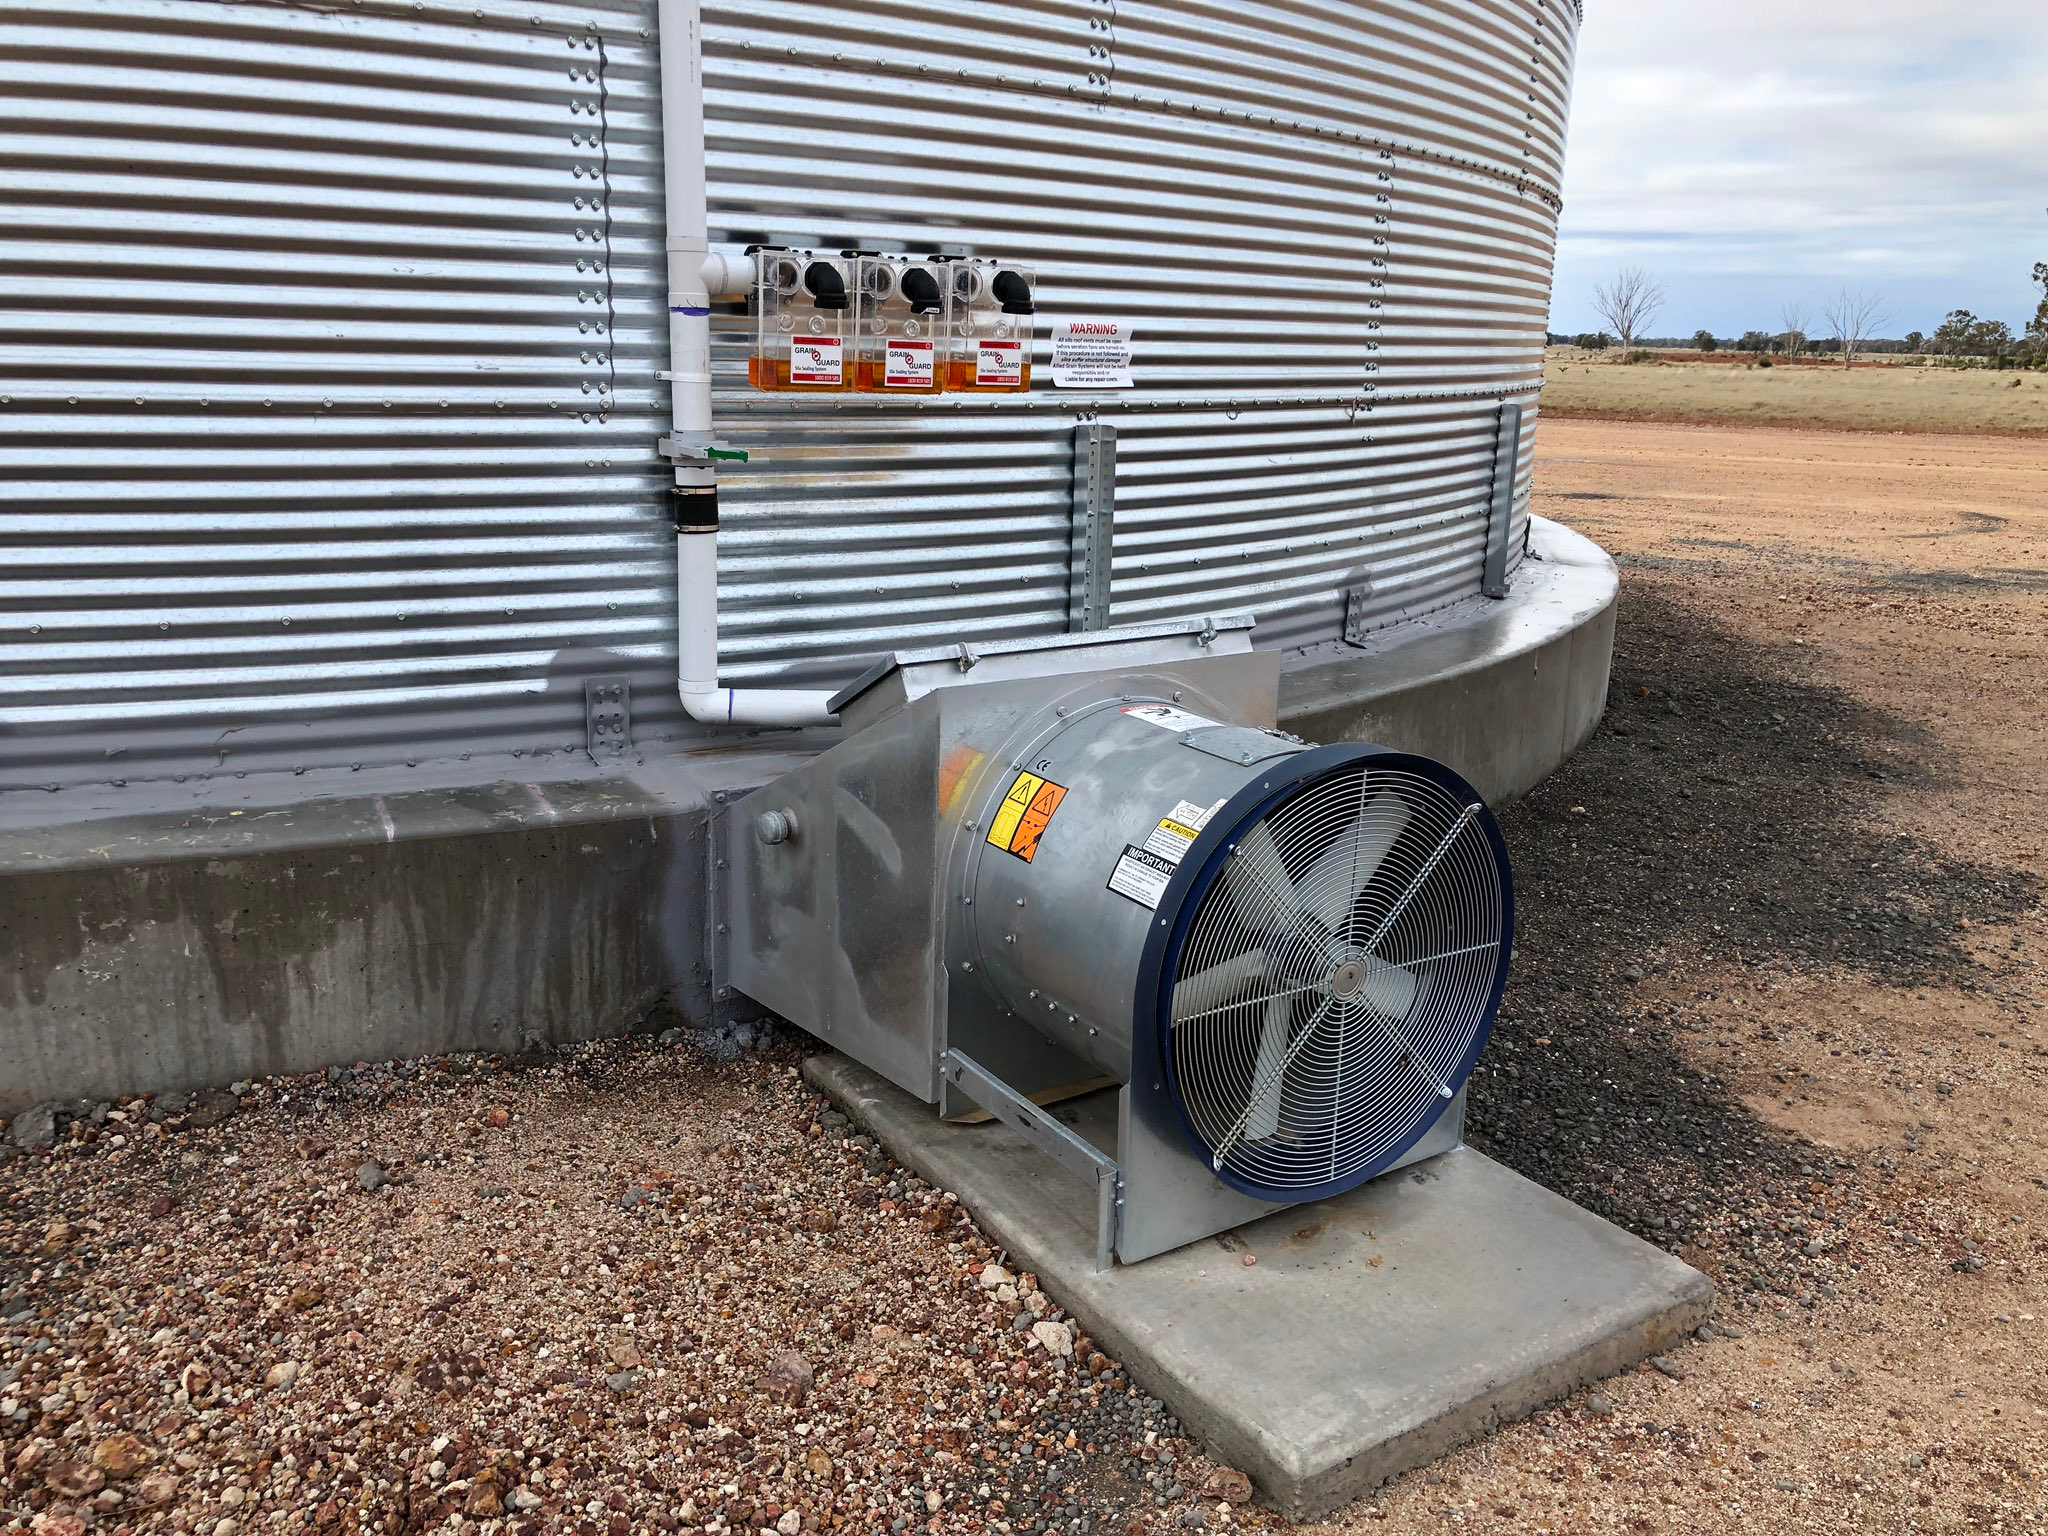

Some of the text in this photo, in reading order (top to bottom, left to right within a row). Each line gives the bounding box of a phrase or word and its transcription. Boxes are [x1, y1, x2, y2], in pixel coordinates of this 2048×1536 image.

[1070, 322, 1118, 335] WARNING
[1171, 825, 1196, 838] CAUTION
[1127, 846, 1176, 875] IMPORTANT
